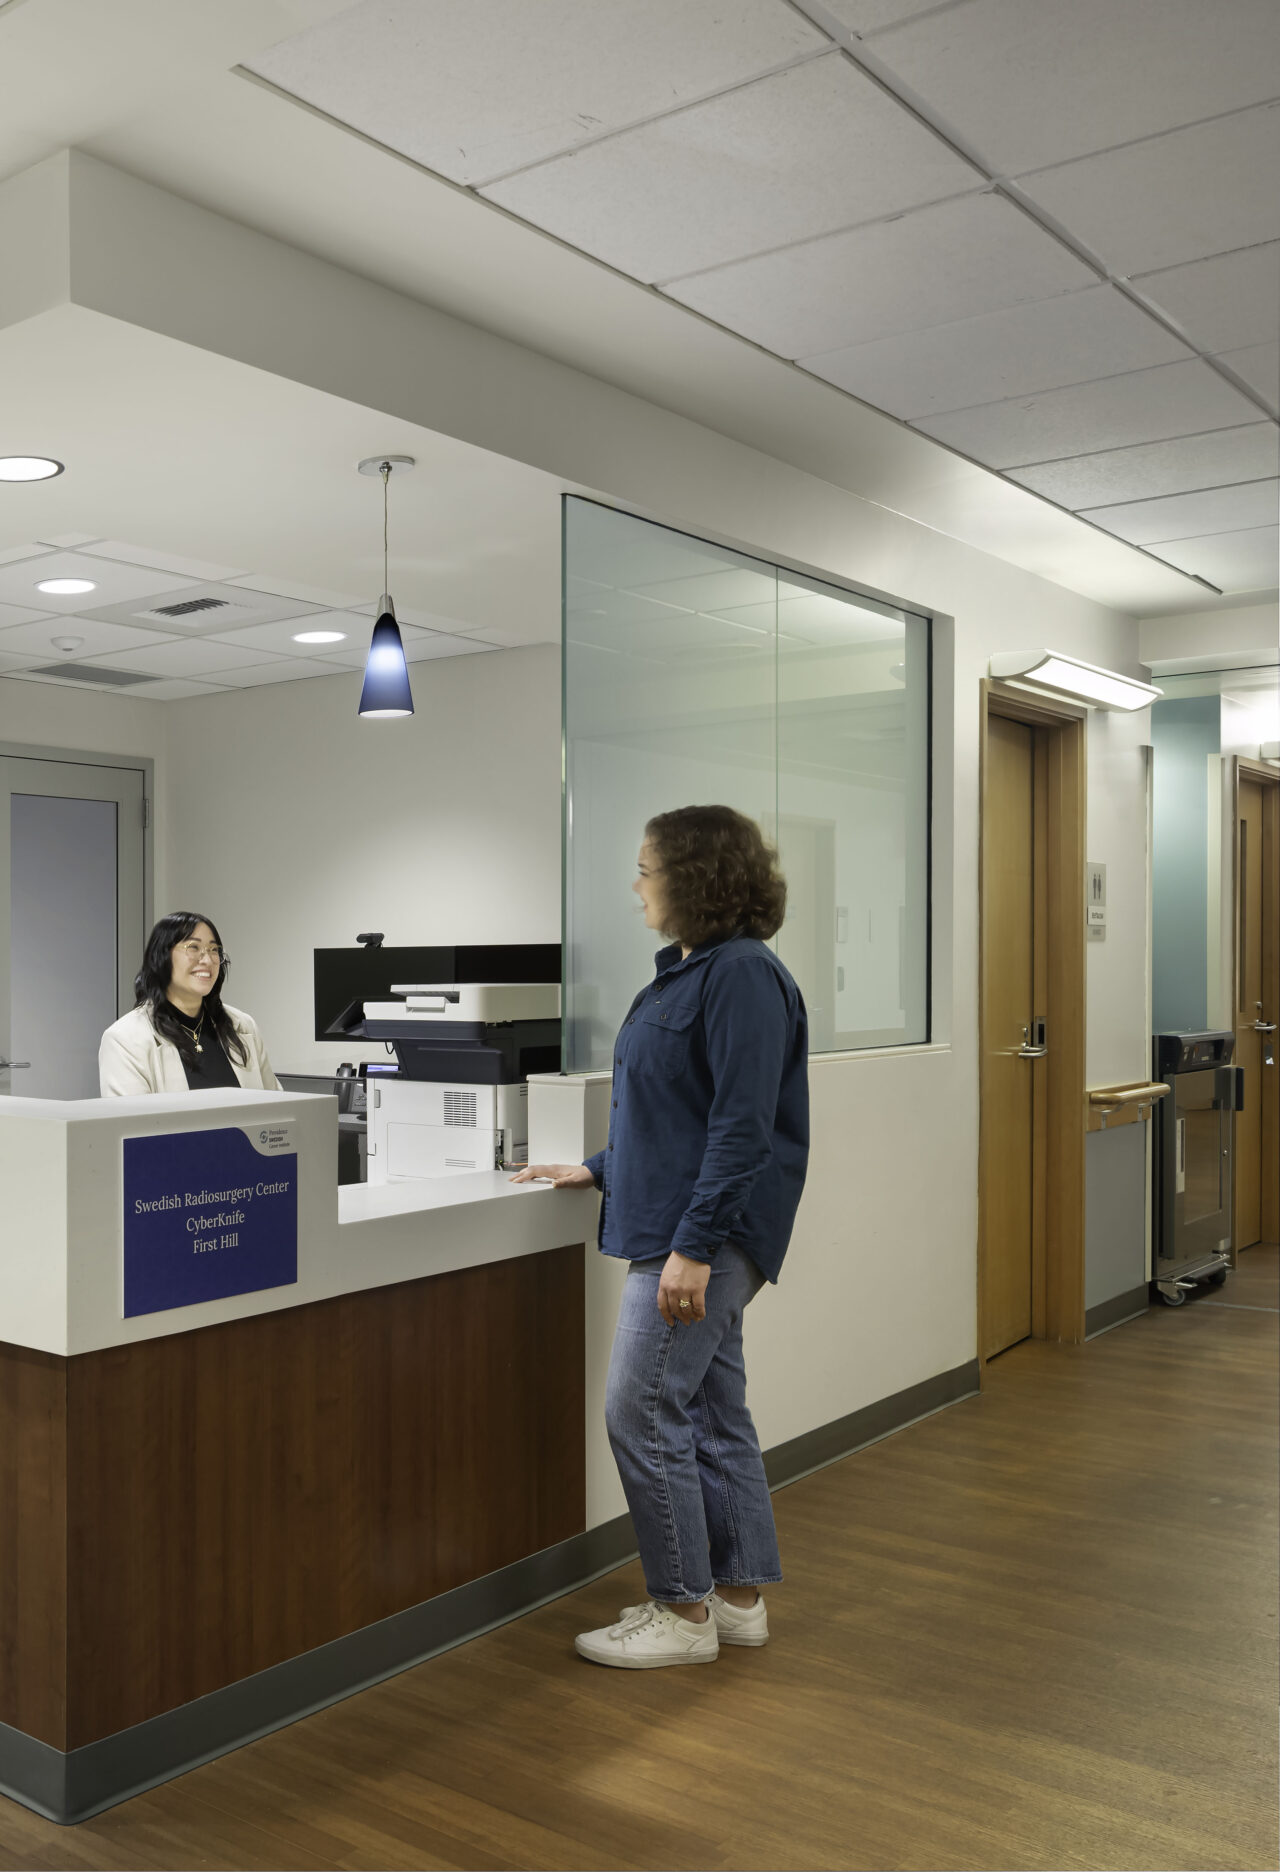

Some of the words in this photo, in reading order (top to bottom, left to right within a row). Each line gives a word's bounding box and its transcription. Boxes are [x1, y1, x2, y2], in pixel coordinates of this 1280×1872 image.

[135, 1193, 182, 1214] Swedish
[184, 1187, 253, 1206] Radiosurgery
[255, 1182, 290, 1195] Center
[186, 1210, 245, 1234] CyberKnife
[193, 1237, 218, 1254] First
[220, 1233, 239, 1249] Hill
